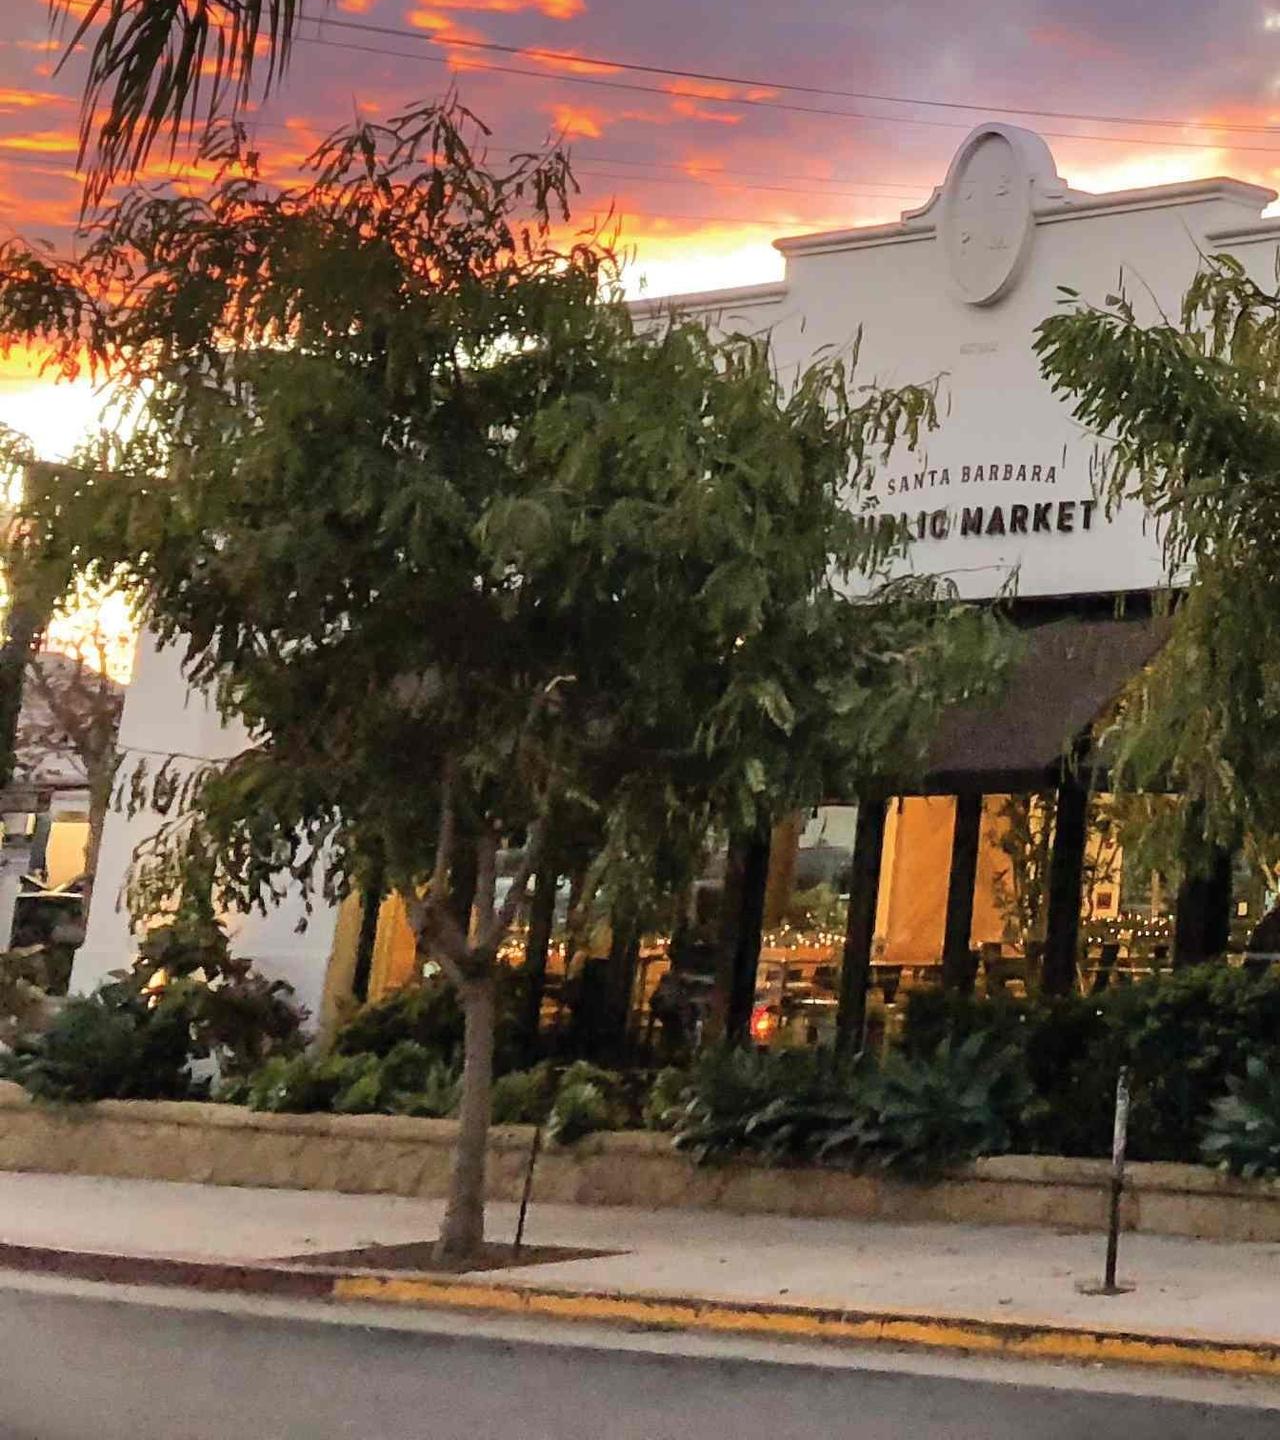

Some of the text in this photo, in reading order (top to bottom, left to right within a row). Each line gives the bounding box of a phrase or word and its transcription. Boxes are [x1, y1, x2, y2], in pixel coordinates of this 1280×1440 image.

[887, 463, 1057, 496] SANTA BARBARA
[959, 499, 1096, 537] MARKET
